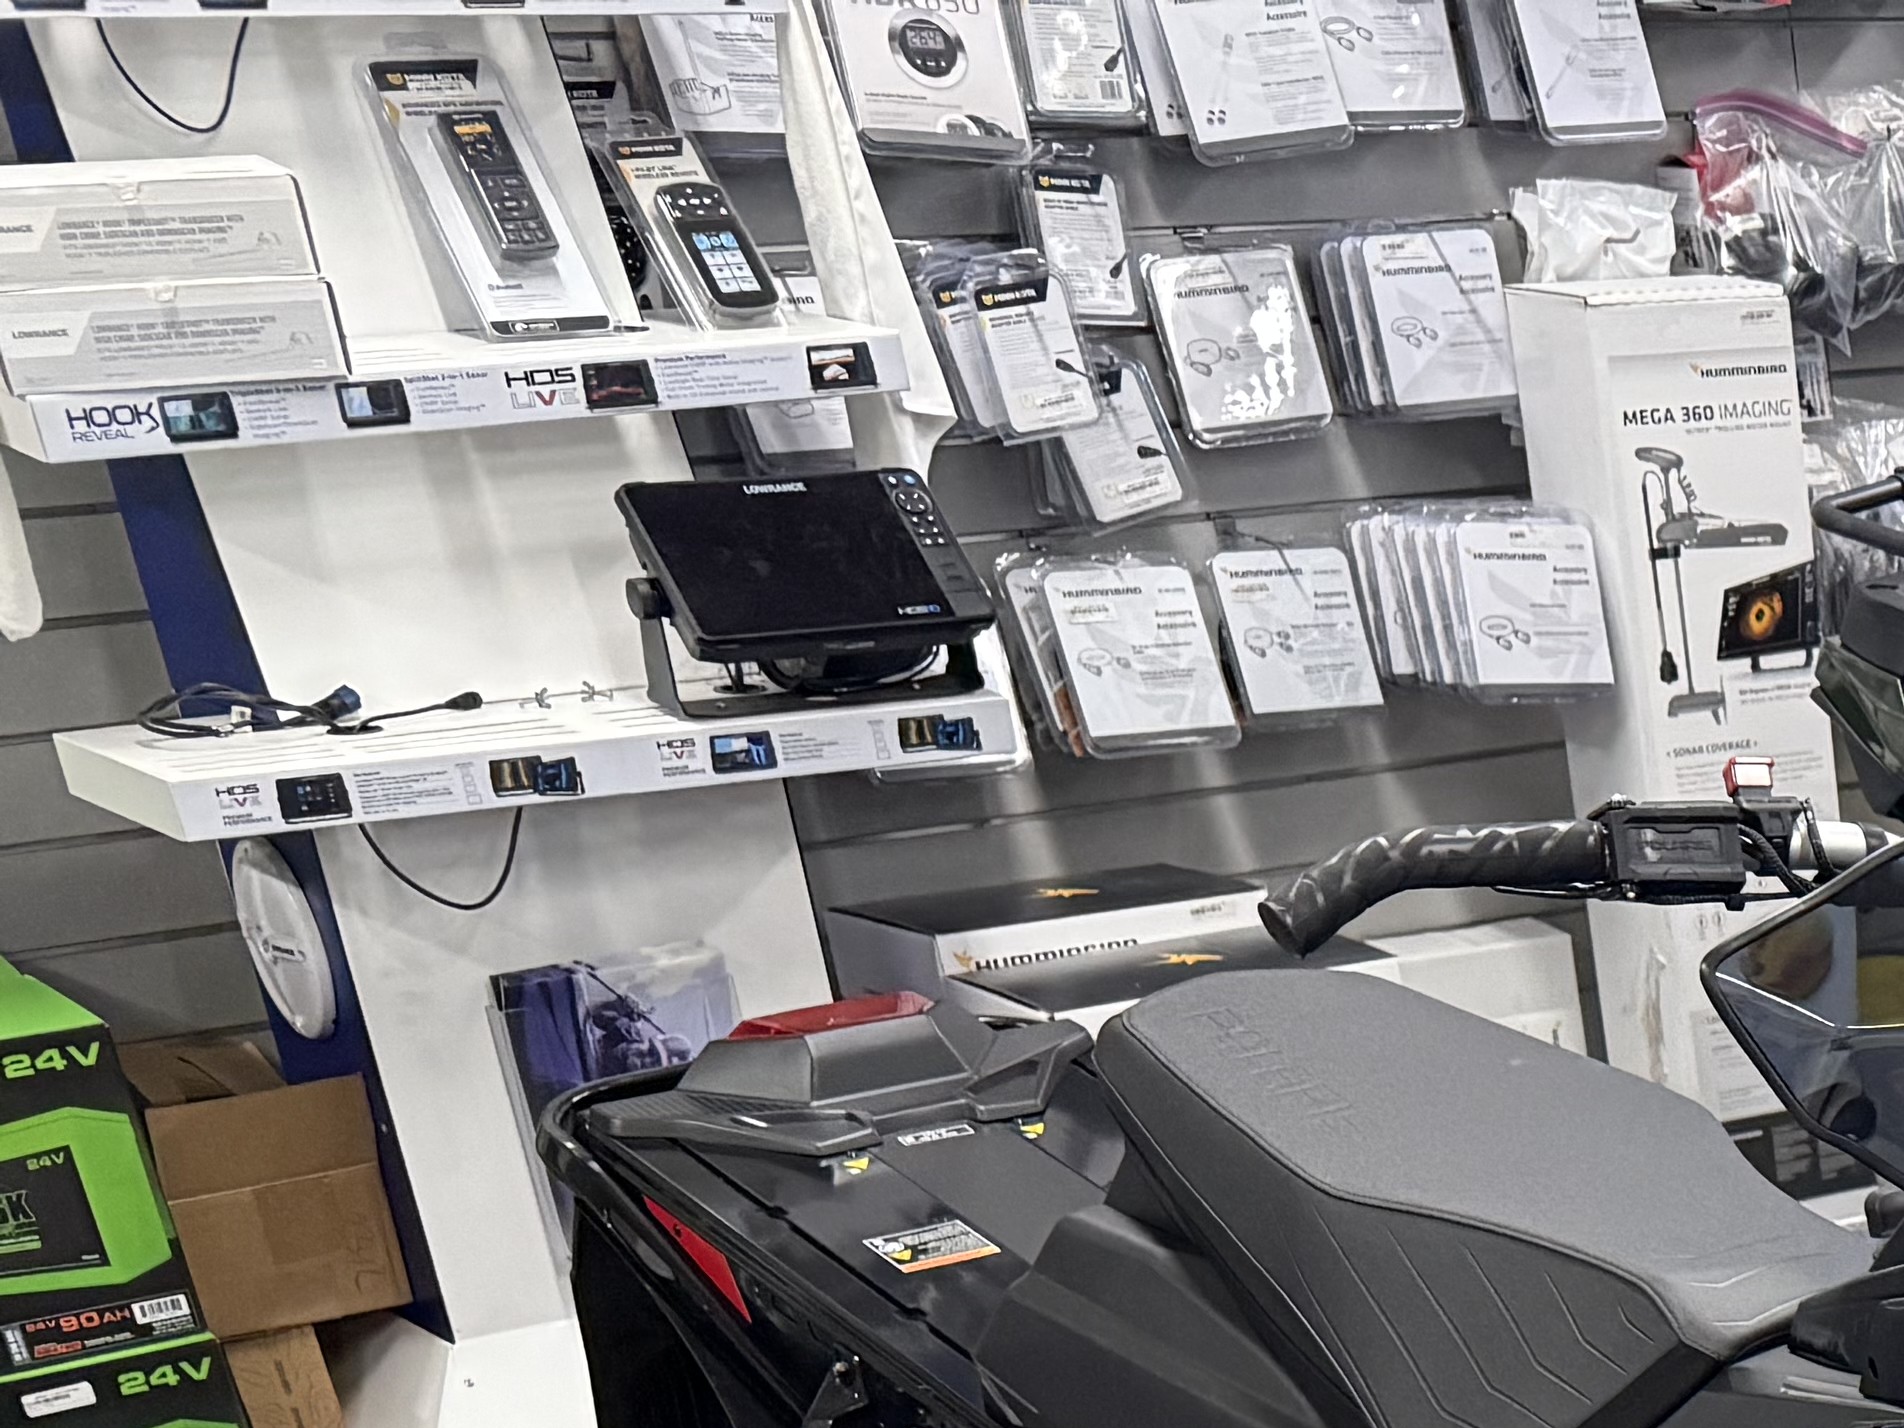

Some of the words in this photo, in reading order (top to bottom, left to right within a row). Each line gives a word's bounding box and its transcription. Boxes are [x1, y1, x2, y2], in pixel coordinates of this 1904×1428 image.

[12, 329, 69, 339] LOWRANCE
[504, 367, 576, 388] HDS
[1701, 364, 1788, 378] HUMMINBIRD
[510, 388, 580, 410] LIVE
[66, 402, 160, 434] HOOK
[1623, 407, 1676, 427] MEGA
[1681, 405, 1714, 423] 360
[1718, 399, 1793, 420] IMAGING
[72, 428, 135, 442] REVEAL
[742, 482, 807, 495] LOWRANCE
[1062, 587, 1143, 598] HUMMINBIRD
[1673, 746, 1704, 758] SONAR
[1706, 739, 1751, 755] COVERAGE
[2, 1042, 100, 1080] 24V
[26, 1152, 65, 1171] 24V
[25, 1319, 56, 1333] 24V
[117, 1356, 212, 1396] 24V
